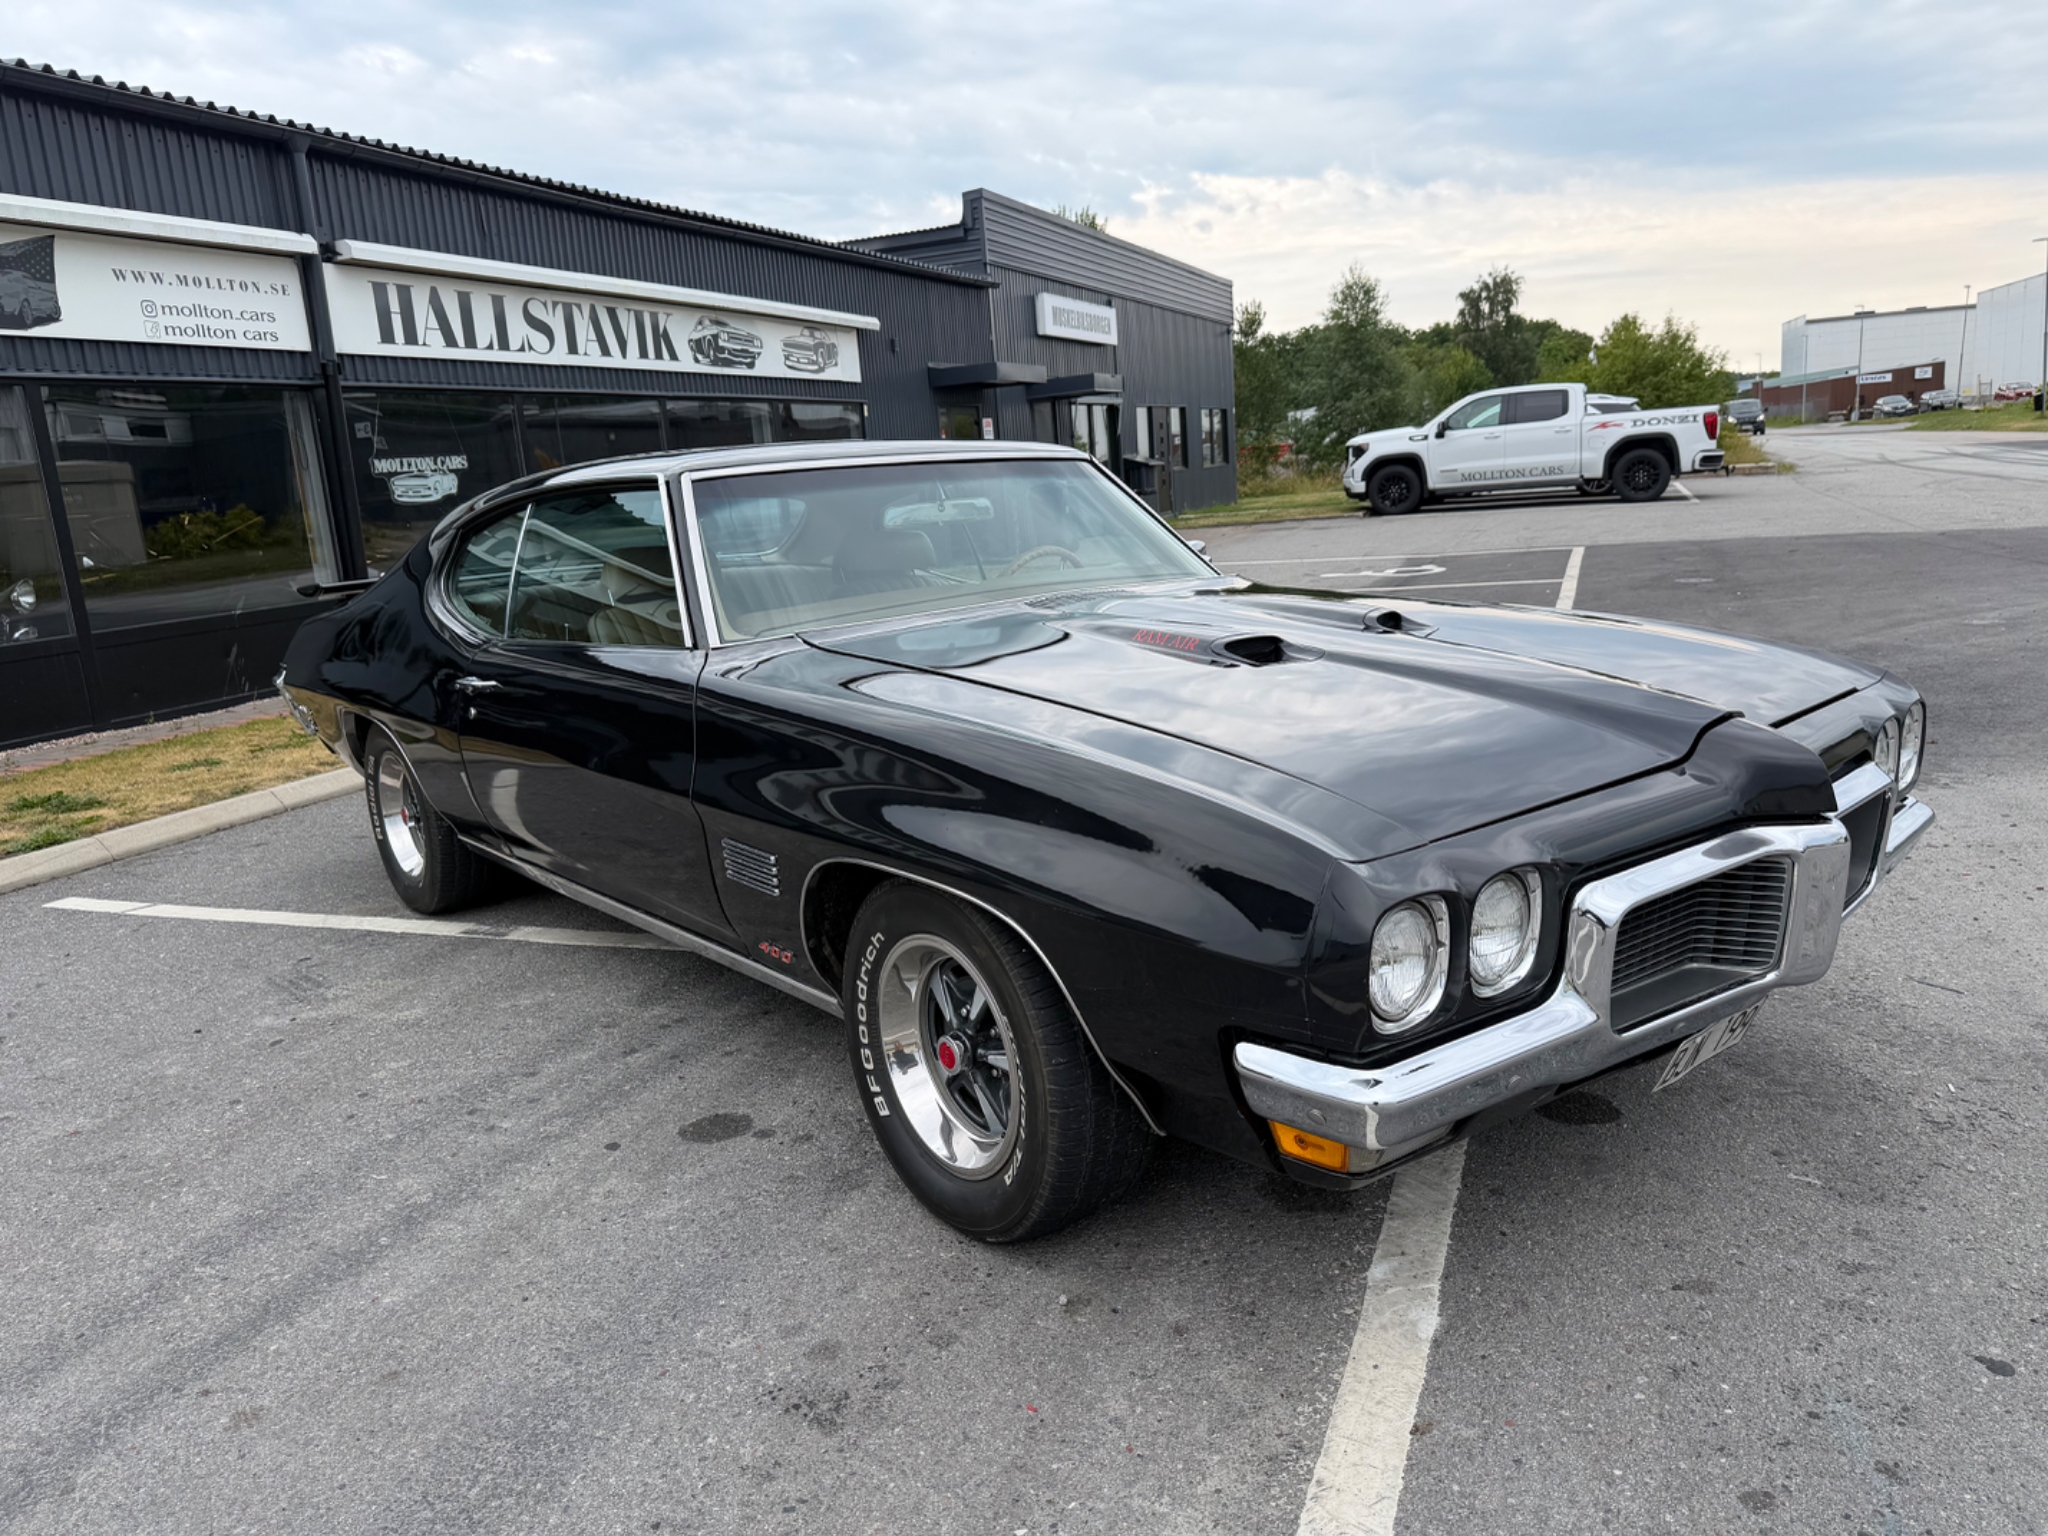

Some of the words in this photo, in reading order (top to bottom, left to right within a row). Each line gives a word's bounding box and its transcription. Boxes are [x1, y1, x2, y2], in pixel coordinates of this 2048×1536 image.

[111, 267, 291, 297] WWW.MOLLTON.SE
[160, 303, 277, 323] mollton_cars
[367, 280, 681, 362] HALLSTAVIK
[164, 323, 237, 340] mollton
[243, 329, 279, 342] cars
[1630, 413, 1700, 428] DONZI
[1460, 467, 1526, 482] MOLLTON
[1528, 465, 1564, 478] CARS
[1131, 628, 1172, 647] RAM
[1167, 634, 1201, 652] AIR
[758, 941, 793, 965] 400
[1713, 1004, 1760, 1052] 199
